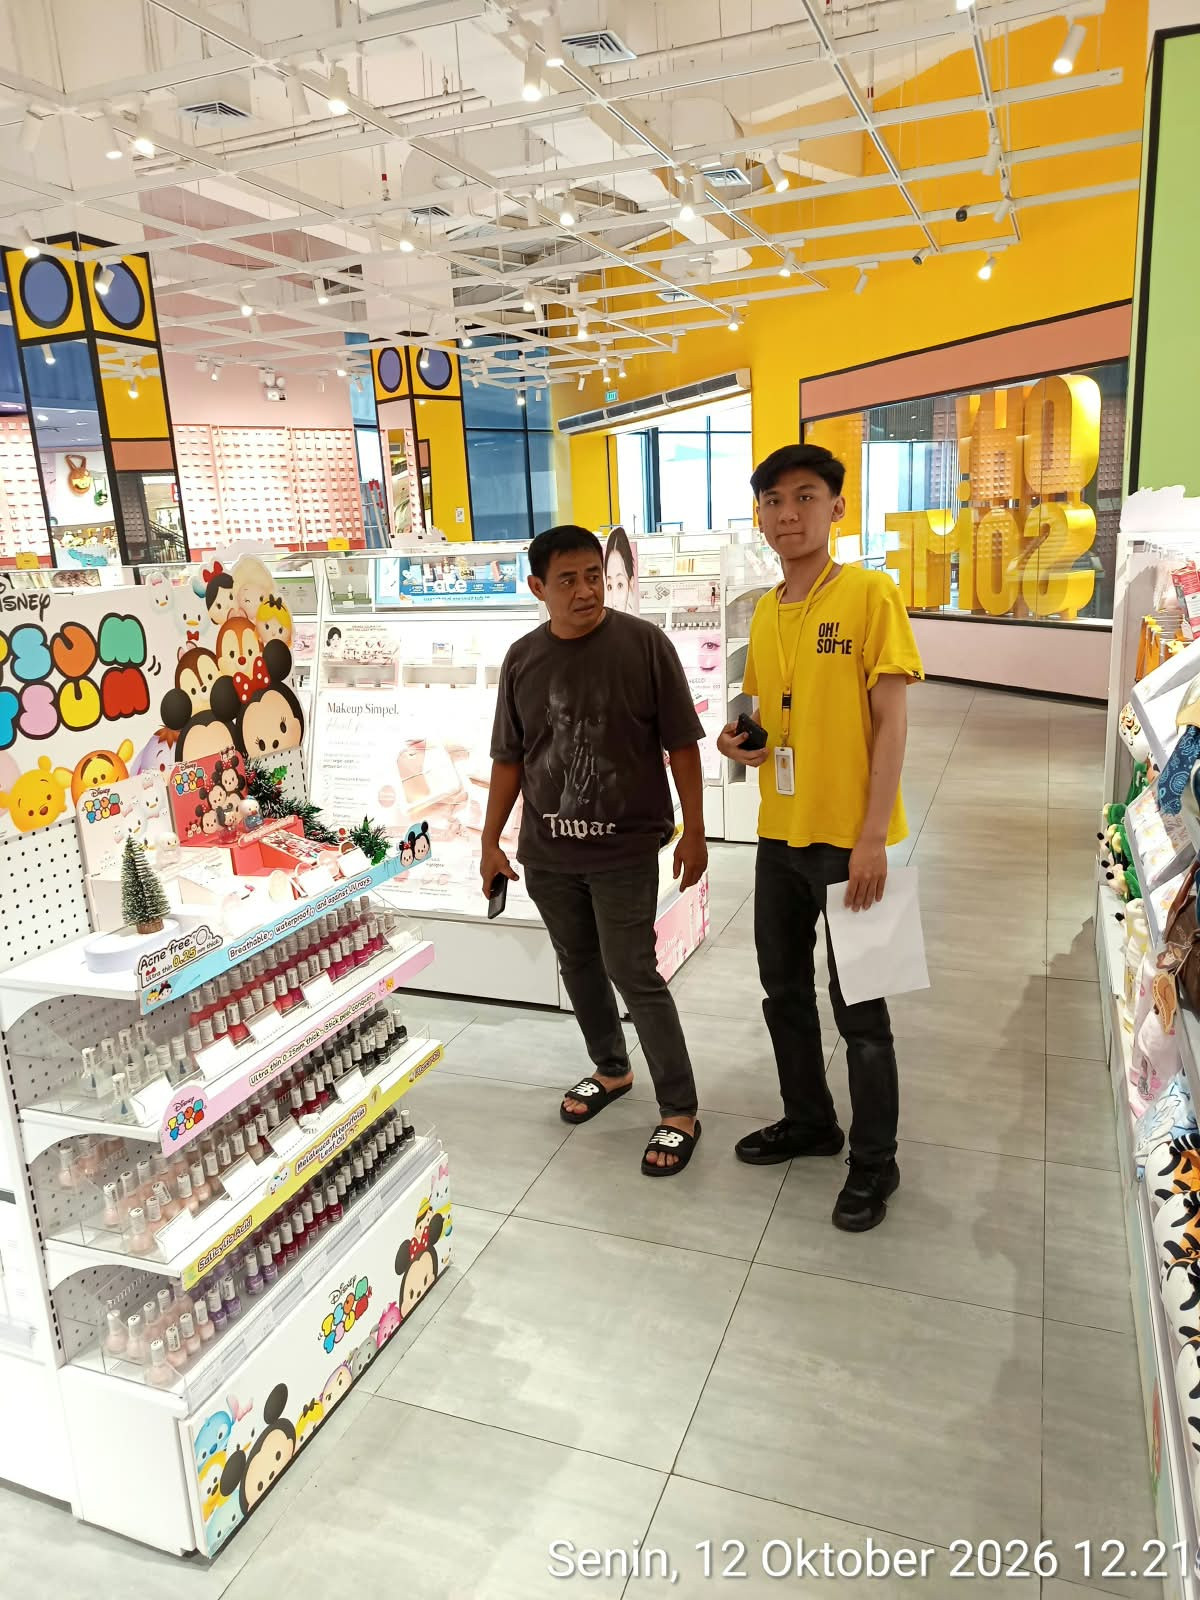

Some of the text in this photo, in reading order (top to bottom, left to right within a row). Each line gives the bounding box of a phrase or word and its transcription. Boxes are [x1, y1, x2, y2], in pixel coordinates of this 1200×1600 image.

[818, 622, 840, 638] OH!
[0, 613, 147, 683] SUM
[816, 638, 853, 655] SOME
[327, 702, 400, 718] Makeup Simpel.
[542, 812, 617, 840] Tupac
[140, 951, 166, 971] Acne
[146, 971, 161, 982] Ultra
[162, 964, 173, 974] thin
[172, 946, 197, 968] 0.25
[250, 1068, 269, 1084] Ultra
[270, 1059, 282, 1074] thin
[324, 1019, 339, 1031] Stick
[173, 1096, 195, 1112] Disney
[320, 1134, 345, 1160] Leaf Oil
[199, 1218, 252, 1270] Salicylic Acid
[328, 1274, 357, 1305] Disney
